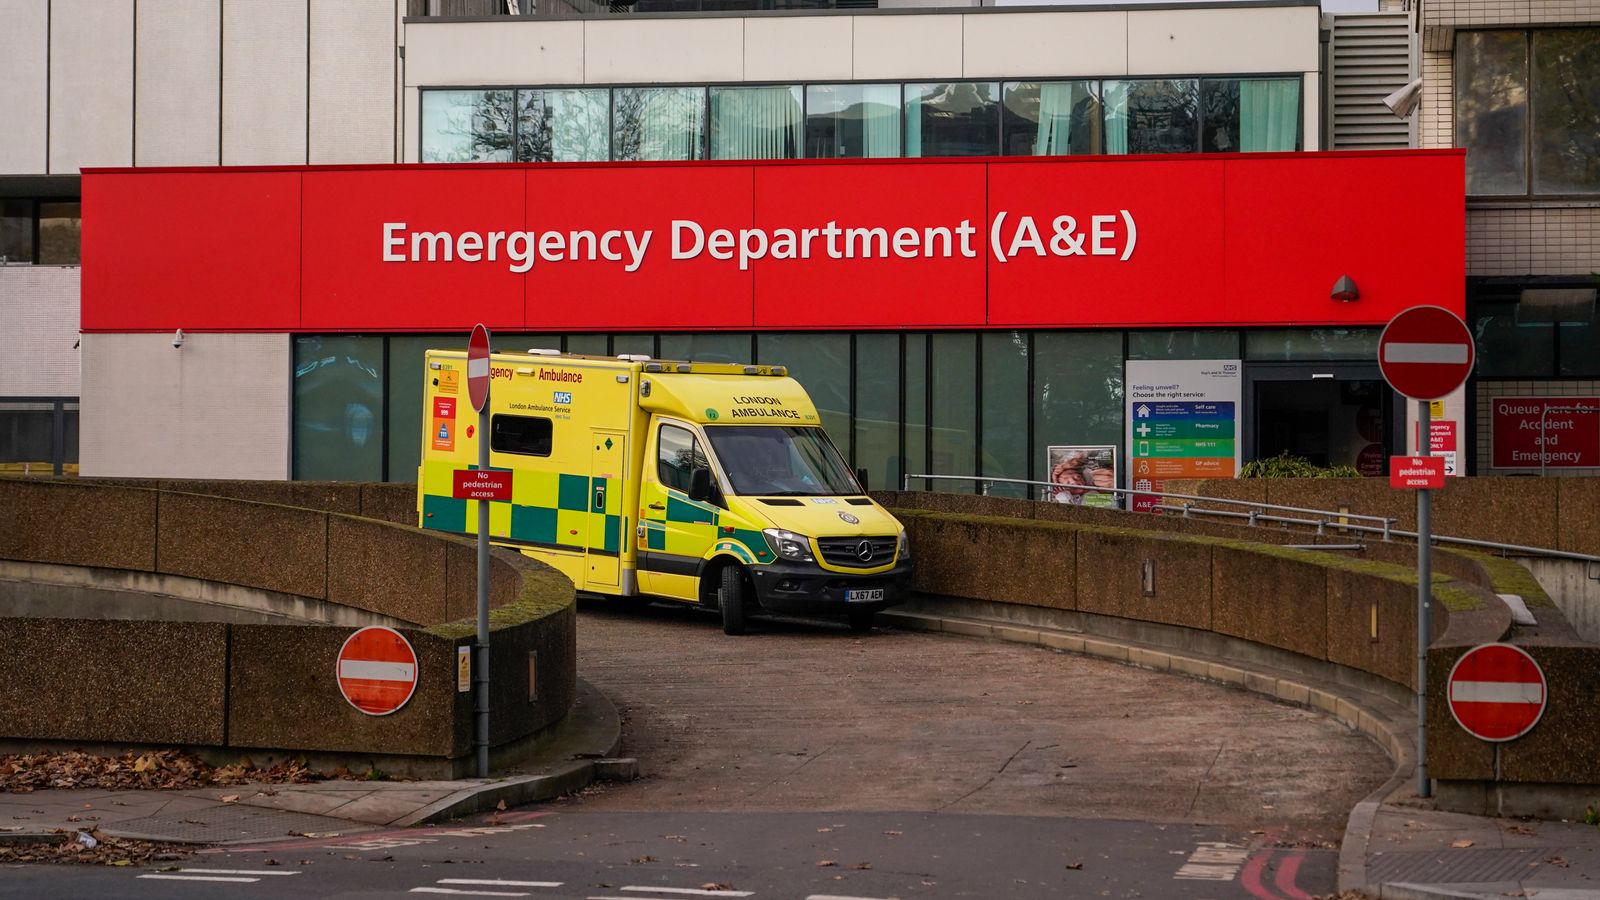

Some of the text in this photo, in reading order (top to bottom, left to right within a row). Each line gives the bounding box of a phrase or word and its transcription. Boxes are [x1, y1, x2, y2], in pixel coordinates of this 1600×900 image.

[382, 210, 1137, 272] Emergency Department (A&E)
[490, 368, 582, 384] gency Ambulance
[554, 392, 571, 404] NHS
[733, 396, 782, 406] LONDON
[528, 404, 554, 412] Ambulance
[732, 408, 800, 420] AMBULANCE
[1498, 404, 1540, 416] Queue
[1520, 418, 1574, 430] Accdent
[1534, 434, 1558, 445] and
[1399, 468, 1436, 477] pedestrian
[850, 591, 869, 600] LX67
